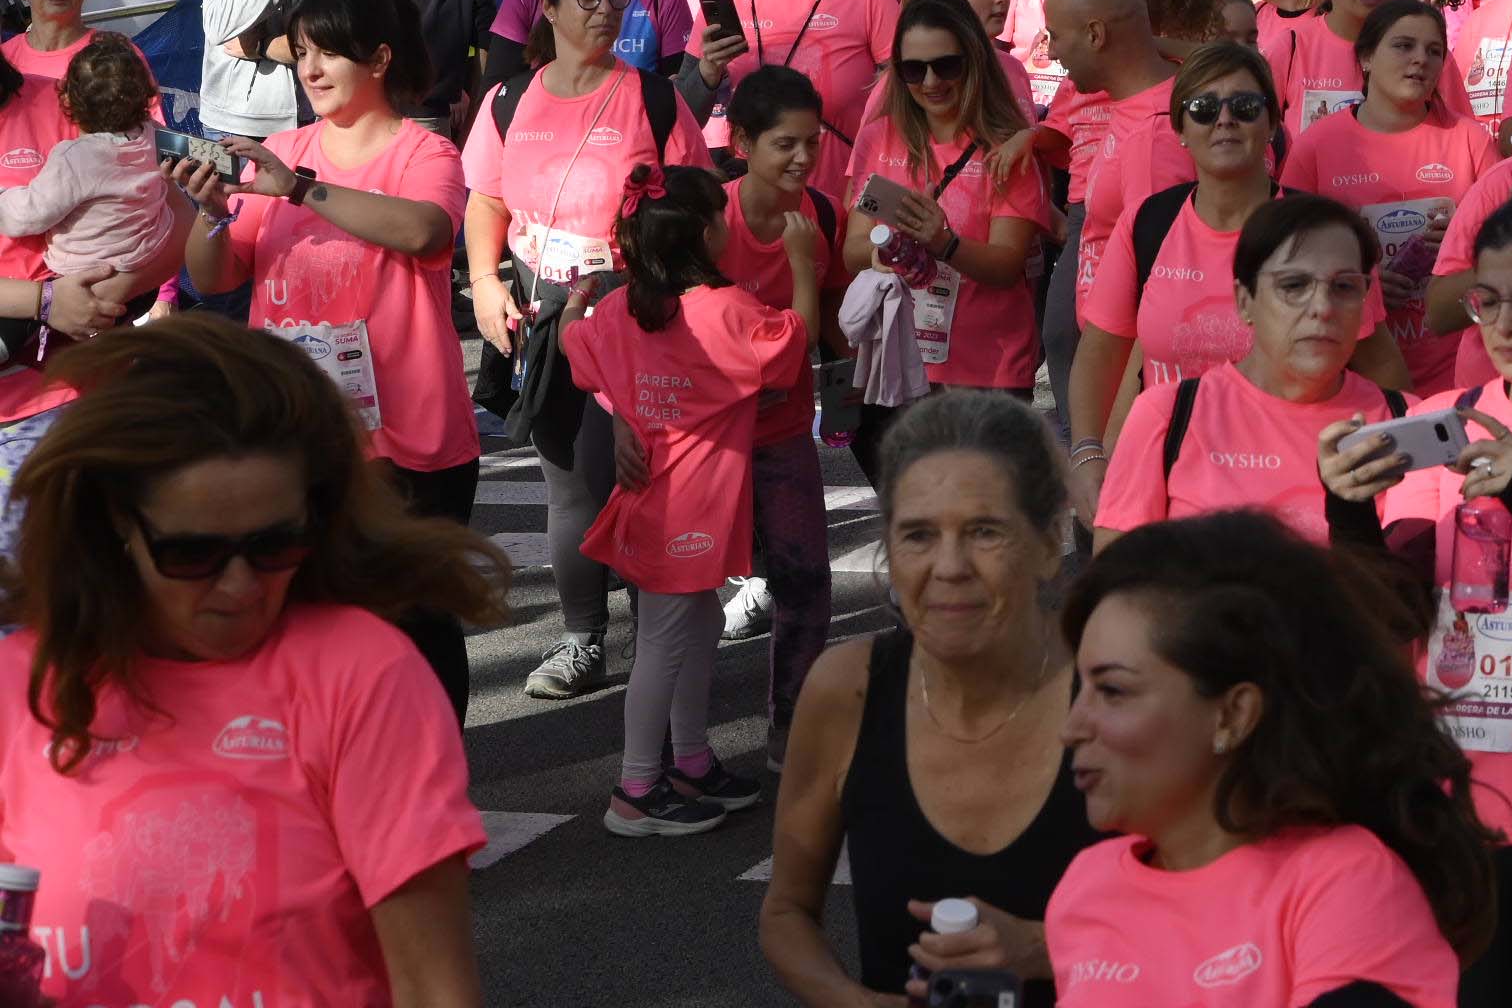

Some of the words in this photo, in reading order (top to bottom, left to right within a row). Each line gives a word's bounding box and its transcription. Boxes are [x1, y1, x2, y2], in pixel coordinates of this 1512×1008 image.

[1332, 172, 1380, 187] OYSHO
[1379, 215, 1423, 230] ASTURIANA
[1155, 264, 1204, 282] OYSHO
[264, 279, 289, 306] TU
[335, 336, 359, 345] SUMA
[1209, 450, 1281, 470] OYSHO
[669, 540, 713, 555] ASTURIANA
[1486, 706, 1500, 715] DE
[33, 925, 91, 981] TU
